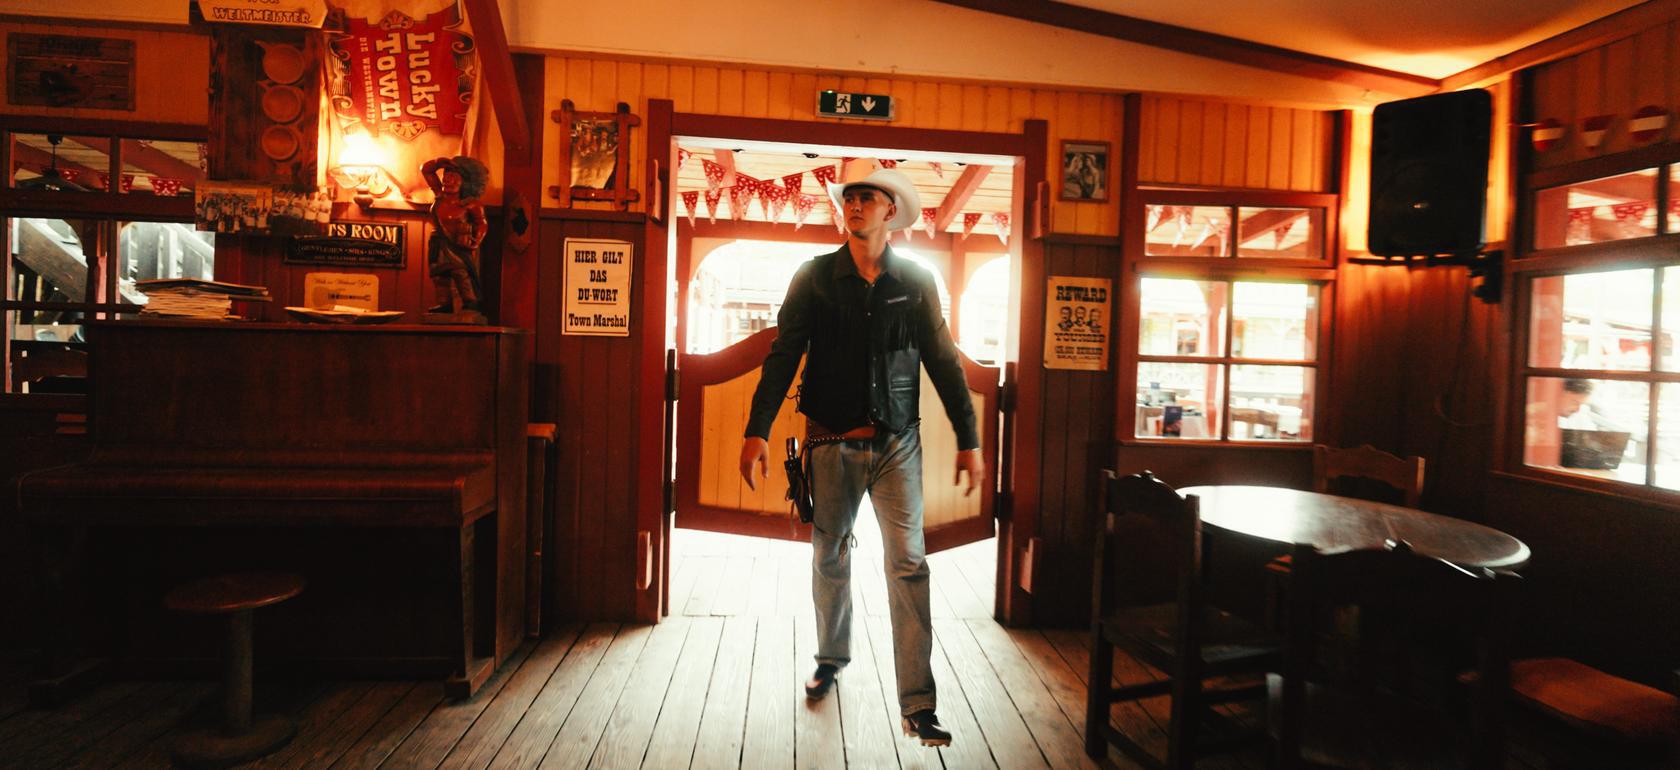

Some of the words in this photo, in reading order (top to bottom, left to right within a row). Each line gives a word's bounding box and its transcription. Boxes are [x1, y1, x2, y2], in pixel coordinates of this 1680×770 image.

[212, 7, 312, 24] WELTMEISTER
[359, 37, 369, 53] DIE
[375, 32, 402, 121] Town
[406, 32, 441, 119] Lucky
[362, 57, 376, 125] WESTERNSTADT
[351, 224, 398, 243] ROOM
[574, 250, 597, 263] HIER
[602, 251, 624, 264] GILT
[590, 270, 607, 282] DAS
[578, 288, 618, 301] DU-WORT
[1055, 286, 1106, 303] REWARD
[568, 313, 591, 326] Town
[593, 314, 627, 327] Marshal
